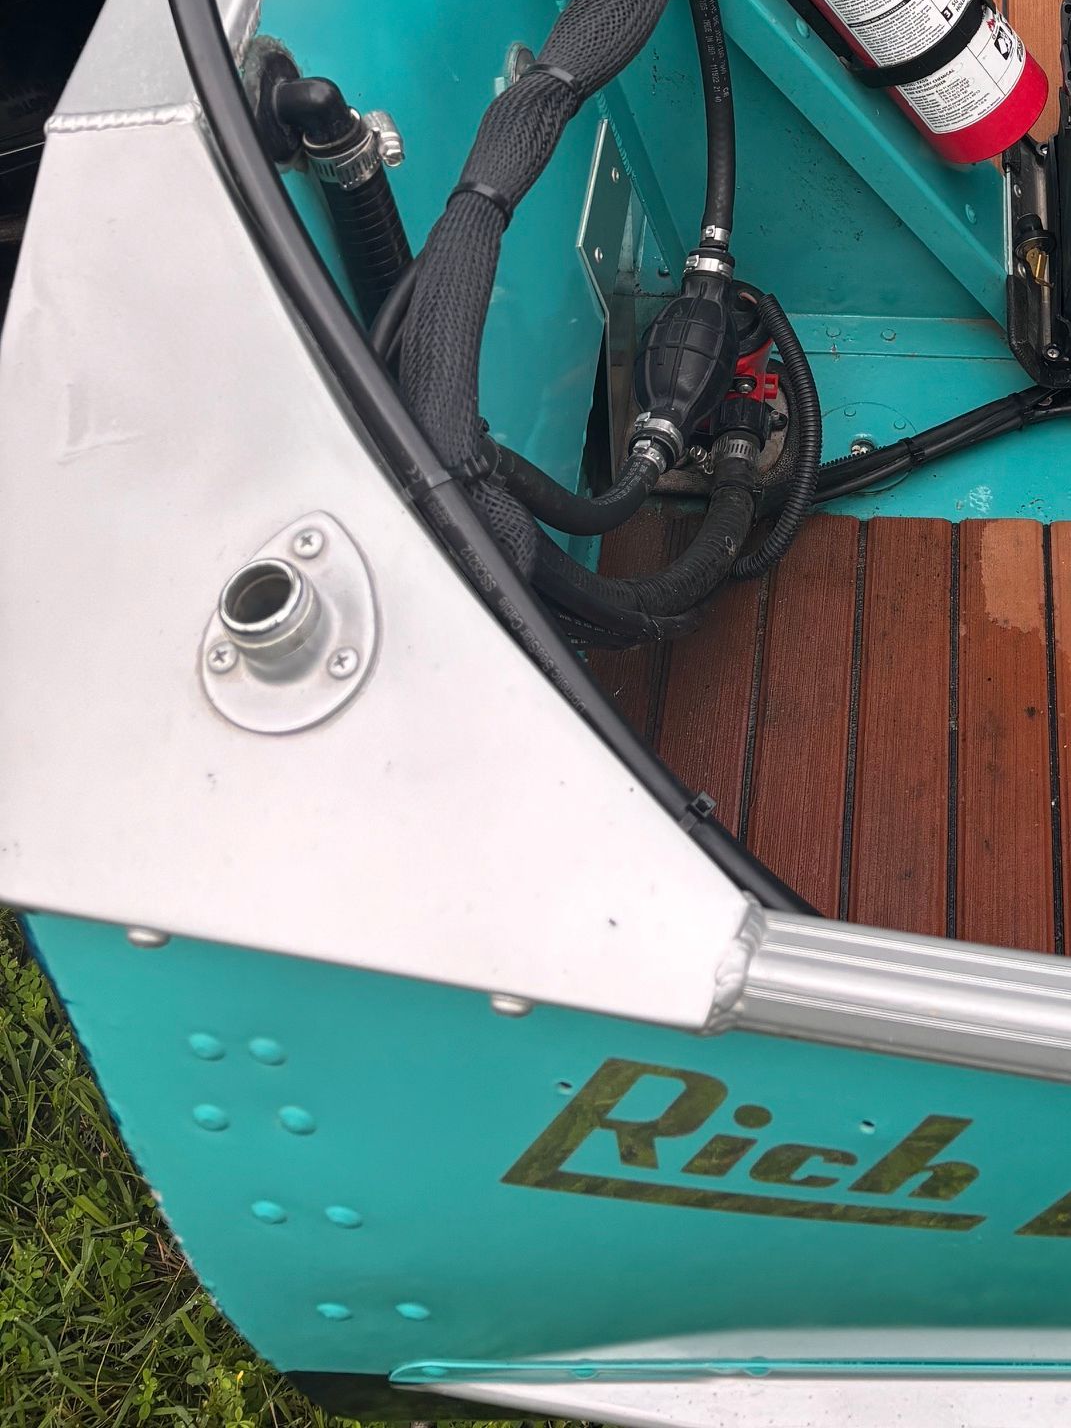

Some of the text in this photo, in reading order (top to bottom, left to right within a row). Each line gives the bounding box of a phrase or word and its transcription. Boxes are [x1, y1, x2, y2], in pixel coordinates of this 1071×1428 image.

[498, 596, 523, 629] Cable
[519, 627, 554, 671] SeaStar
[500, 1057, 987, 1231] Rich
